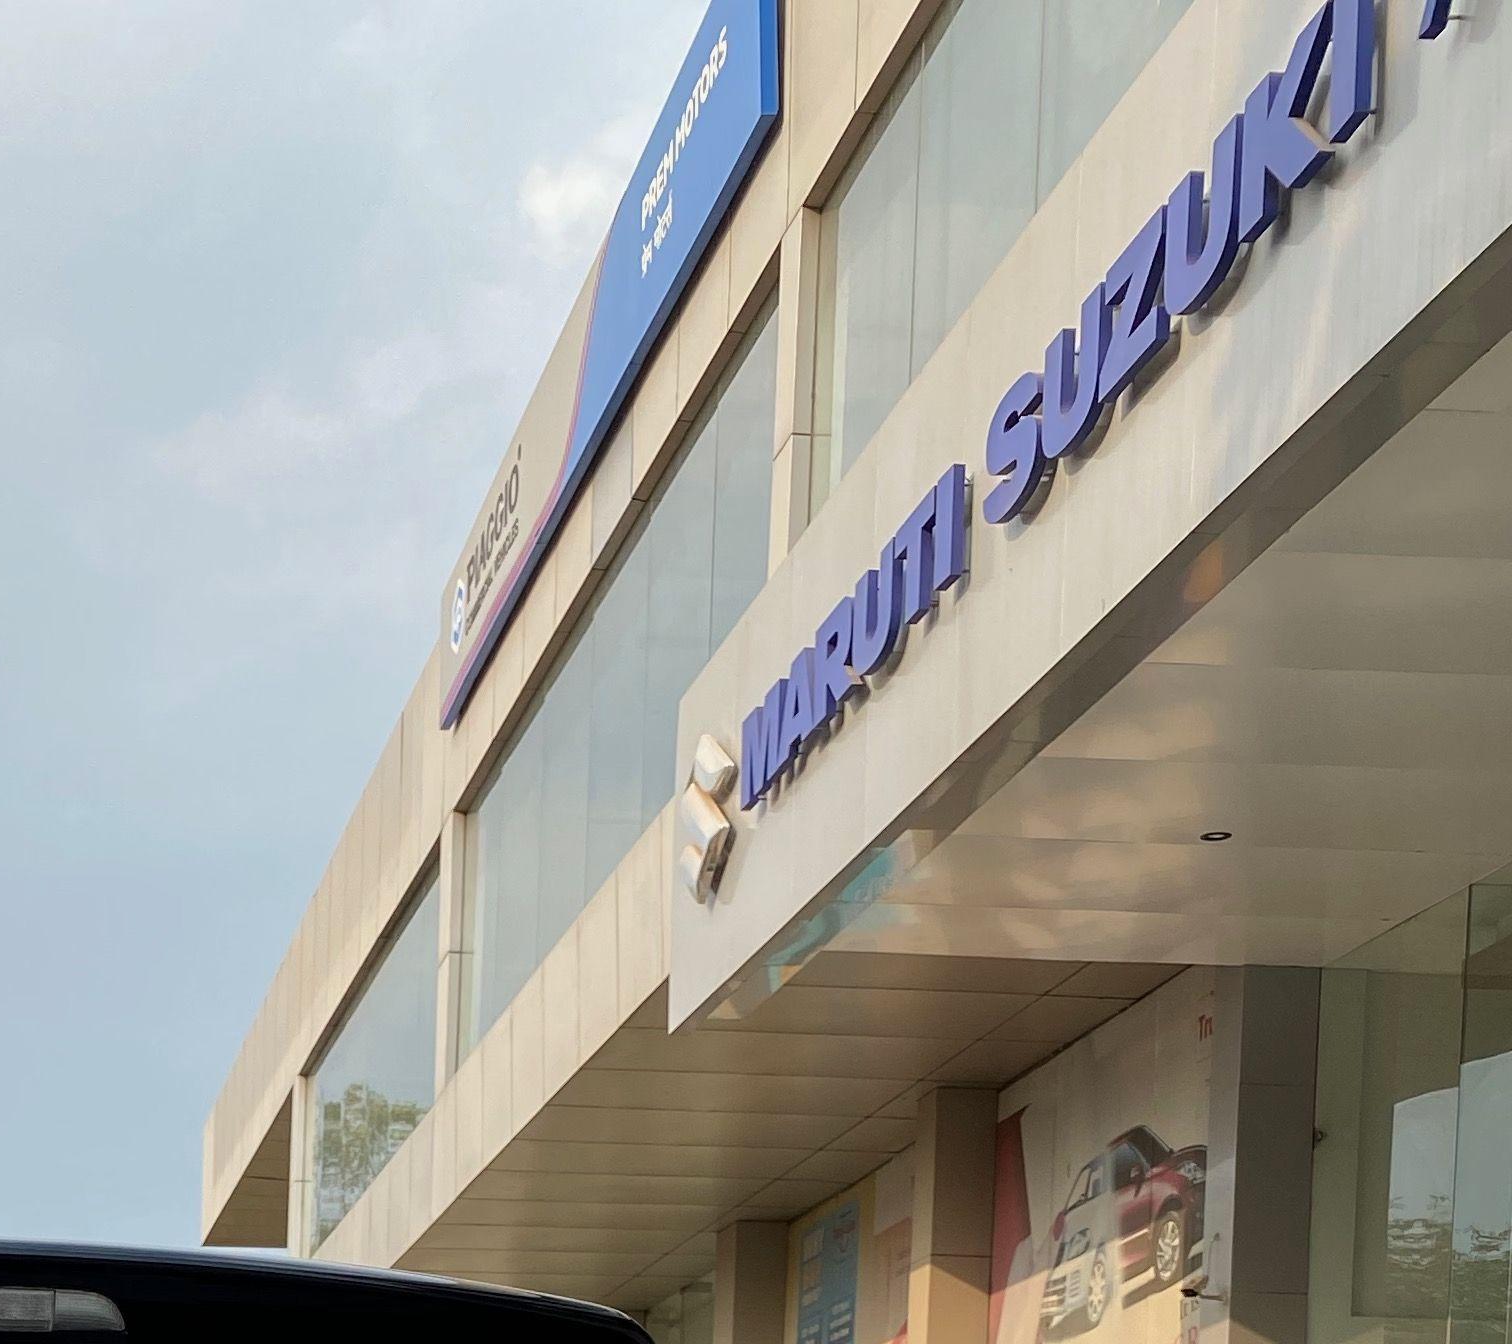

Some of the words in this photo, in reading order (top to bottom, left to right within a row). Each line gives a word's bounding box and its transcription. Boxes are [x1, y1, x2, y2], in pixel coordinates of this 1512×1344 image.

[641, 139, 674, 231] PREM
[675, 24, 728, 163] MOTORS
[741, 464, 966, 811] MARUTI
[983, 0, 1376, 525] SUZUKI
[466, 463, 520, 603] PIAGGIO
